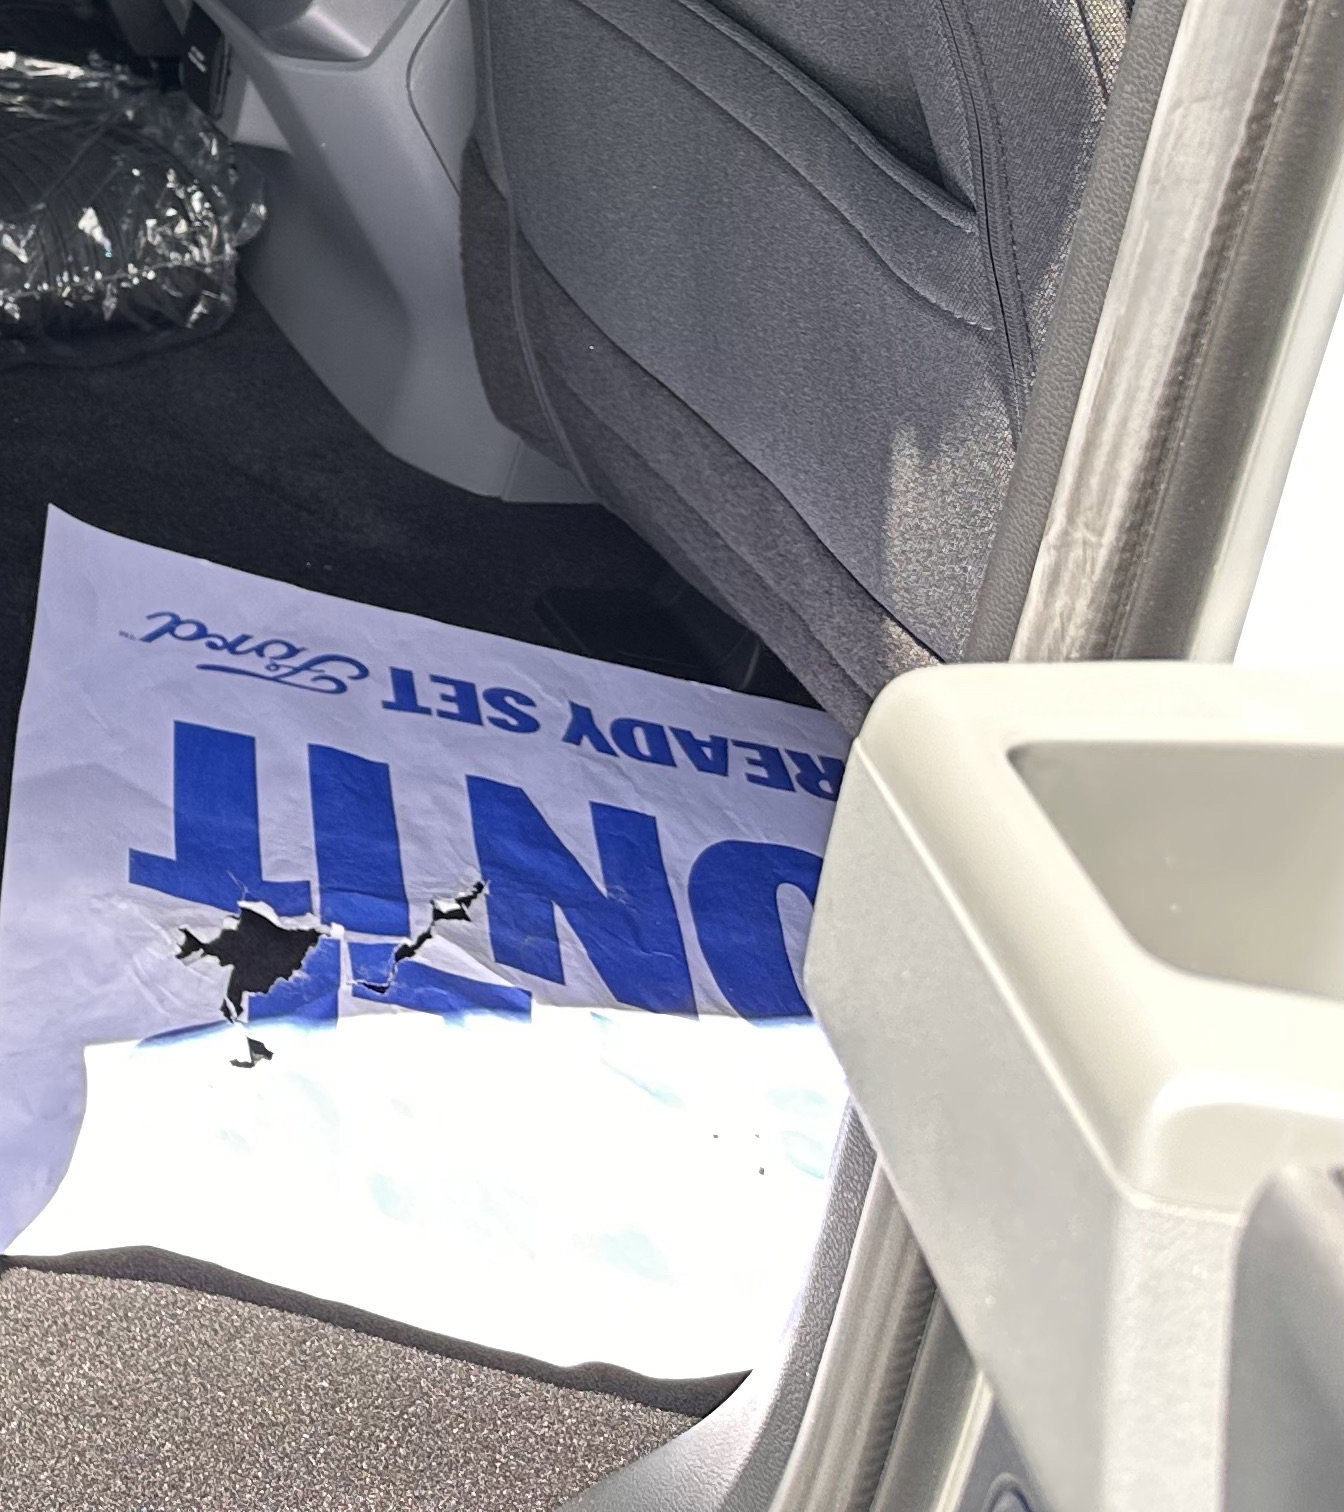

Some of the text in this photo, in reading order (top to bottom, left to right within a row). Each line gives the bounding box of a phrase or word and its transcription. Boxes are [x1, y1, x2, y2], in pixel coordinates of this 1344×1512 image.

[138, 610, 844, 801] READY SET Ford
